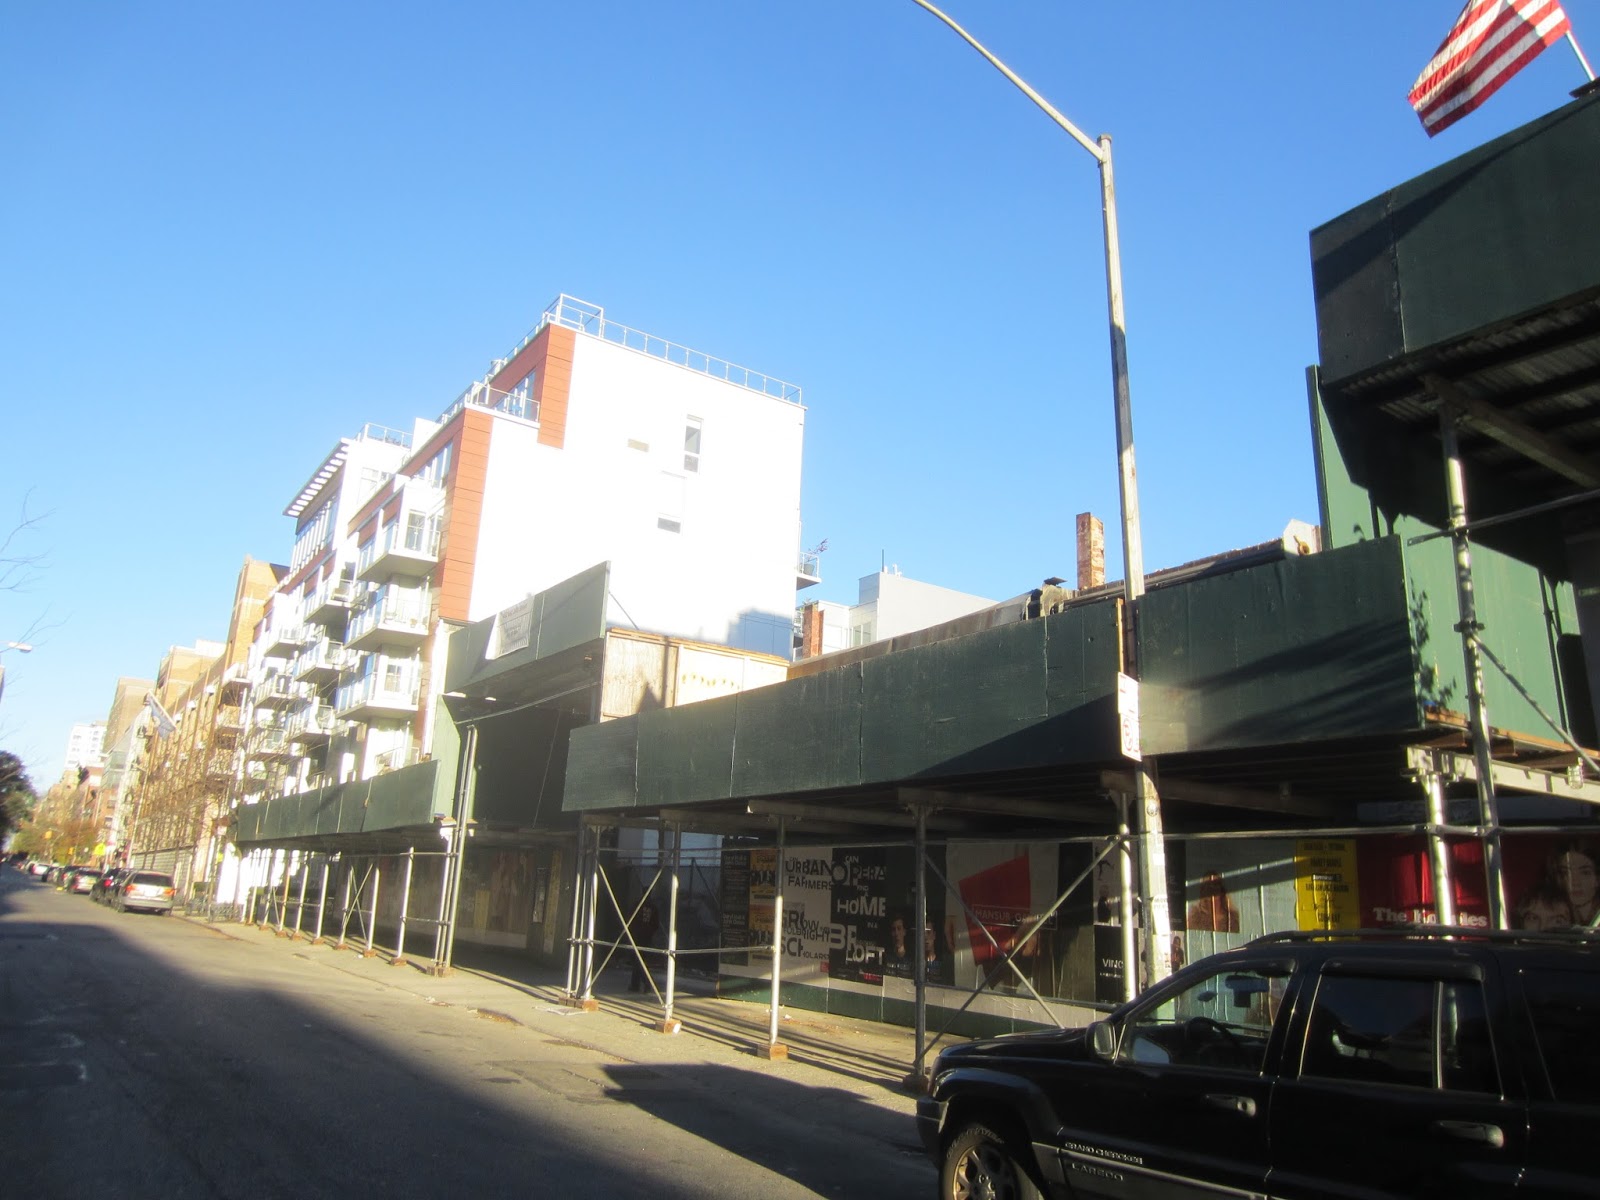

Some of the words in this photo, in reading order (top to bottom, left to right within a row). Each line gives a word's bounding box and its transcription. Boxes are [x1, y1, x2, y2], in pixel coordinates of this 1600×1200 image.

[785, 859, 833, 875] URBAN
[788, 876, 833, 890] FARMERS
[837, 896, 886, 917] HOME
[976, 909, 1011, 922] MANSUR
[1373, 907, 1407, 922] The
[1102, 958, 1124, 969] VINC
[1065, 1142, 1094, 1153] GRAND
[1071, 1162, 1124, 1181] LAREDO
